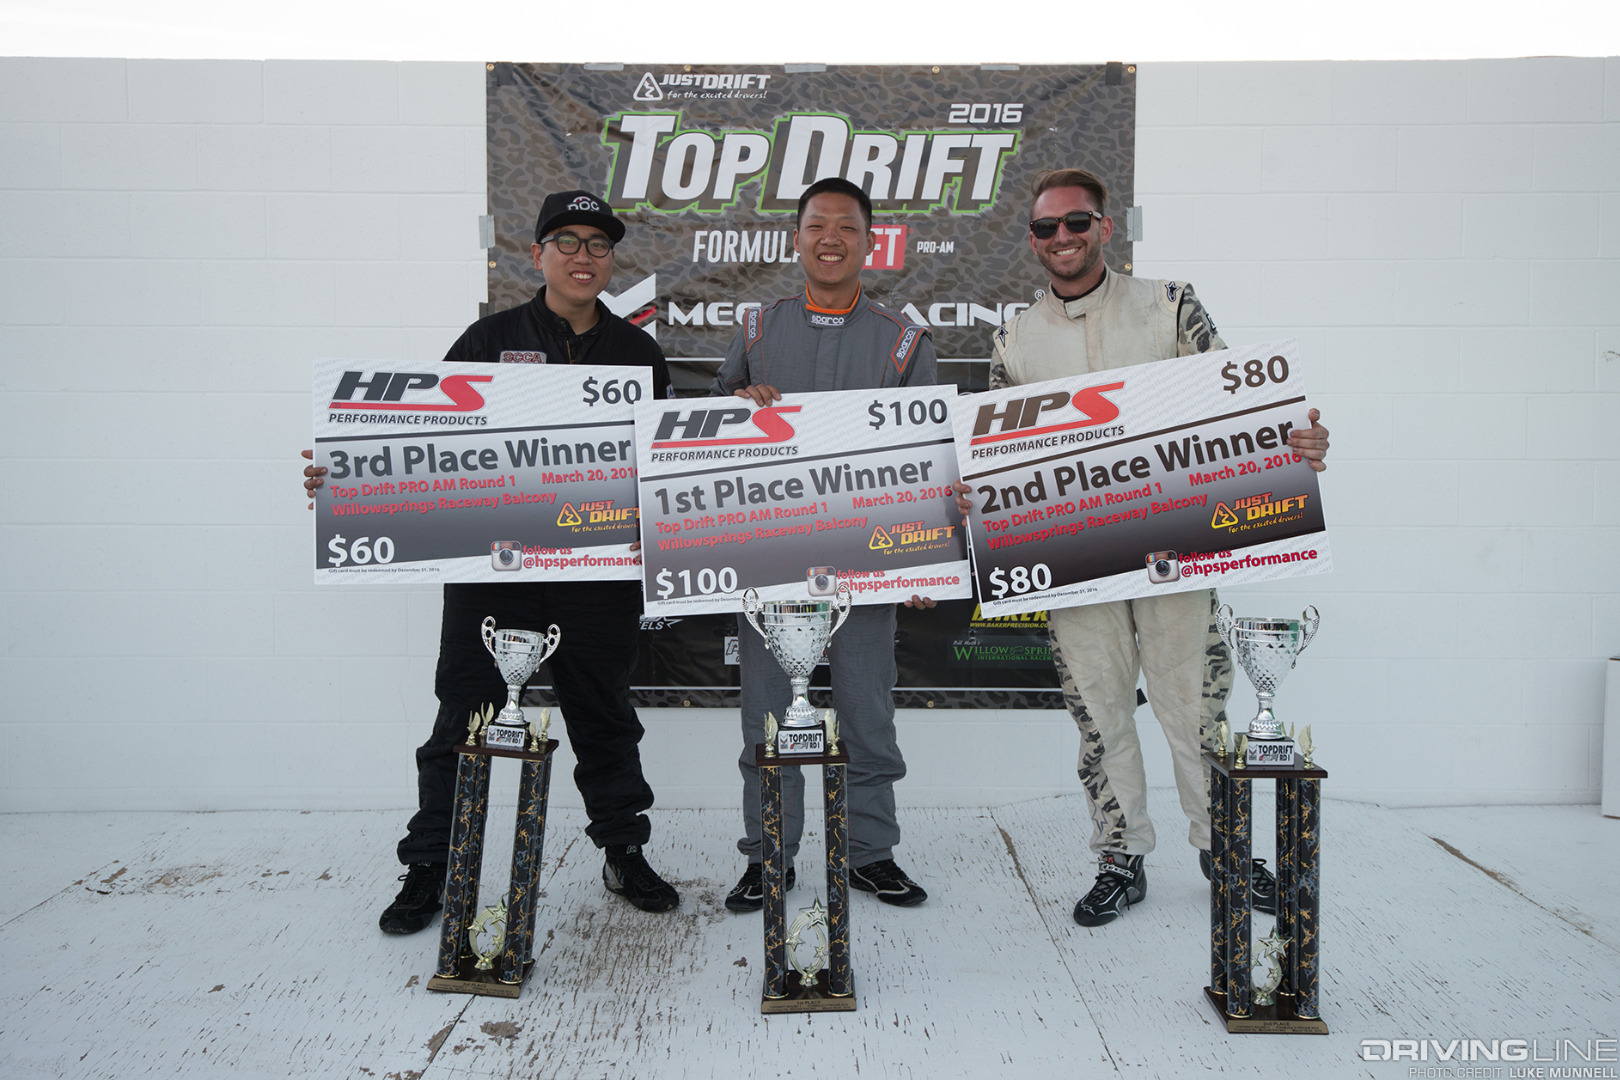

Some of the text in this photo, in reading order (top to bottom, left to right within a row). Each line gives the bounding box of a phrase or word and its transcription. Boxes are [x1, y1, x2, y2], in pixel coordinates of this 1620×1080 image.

[667, 90, 768, 100] for the excited drivers!
[948, 103, 1024, 123] 2016
[916, 241, 954, 254] PRO-AM
[749, 310, 758, 338] sparco
[811, 314, 844, 325] sparco
[896, 330, 916, 359] sparco
[503, 352, 543, 363] SCCA
[1221, 355, 1290, 395] $80
[329, 371, 494, 412] HPS
[582, 376, 642, 407] $60
[329, 413, 487, 426] PERFORMANCE PRODUCTS
[868, 399, 948, 430] $100
[970, 381, 1125, 446] HPS
[651, 405, 802, 449] HPS
[651, 446, 798, 462] PERFORMANCE PRODUCTS
[971, 425, 1125, 460] PERFORMANCE PRODUCTS
[329, 437, 632, 479] 3rd Place Winner
[977, 420, 1294, 514] 2nd Place Winner
[330, 485, 358, 499] Top
[361, 482, 396, 497] Drift
[399, 480, 429, 494] PRO
[432, 479, 456, 491] AM
[459, 475, 505, 489] Round
[510, 475, 516, 487] 1
[542, 470, 583, 485] March
[587, 469, 608, 482] 20,
[655, 460, 933, 515] 1st Place Winner
[983, 453, 1302, 532] Top Drift PRO AM Round 1 March 20, 2016
[332, 492, 557, 516] Willowsprings Raceway Balcony
[578, 500, 614, 513] JUST
[655, 485, 953, 534] Top Drift PRO AM Round 1 March 20, 2016
[1233, 492, 1272, 511] JUST
[1246, 494, 1309, 521] DRIFT
[594, 523, 616, 531] excited
[889, 521, 925, 535] JUST
[986, 493, 1208, 550] Willowsprings Raceway Balcony
[1240, 522, 1251, 530] the
[1253, 517, 1277, 528] excited
[1278, 511, 1304, 524] drivers!
[657, 516, 868, 551] Willowsprings Raceway Balcony
[901, 525, 955, 545] DRIFT
[328, 534, 395, 568] $60
[522, 545, 572, 555] follow us
[905, 545, 927, 553] excited
[1179, 550, 1232, 564] follow us
[837, 569, 886, 580] follow us
[1181, 549, 1318, 577] @hpsperformance
[656, 566, 738, 600] $100
[838, 575, 960, 593] @hpsperformance
[989, 562, 1052, 599] $80
[953, 646, 1009, 661] WILLOW
[496, 729, 524, 738] TOPDRIFT
[789, 733, 822, 743] TOPDRIFT
[1258, 745, 1293, 754] TOPDRIFT
